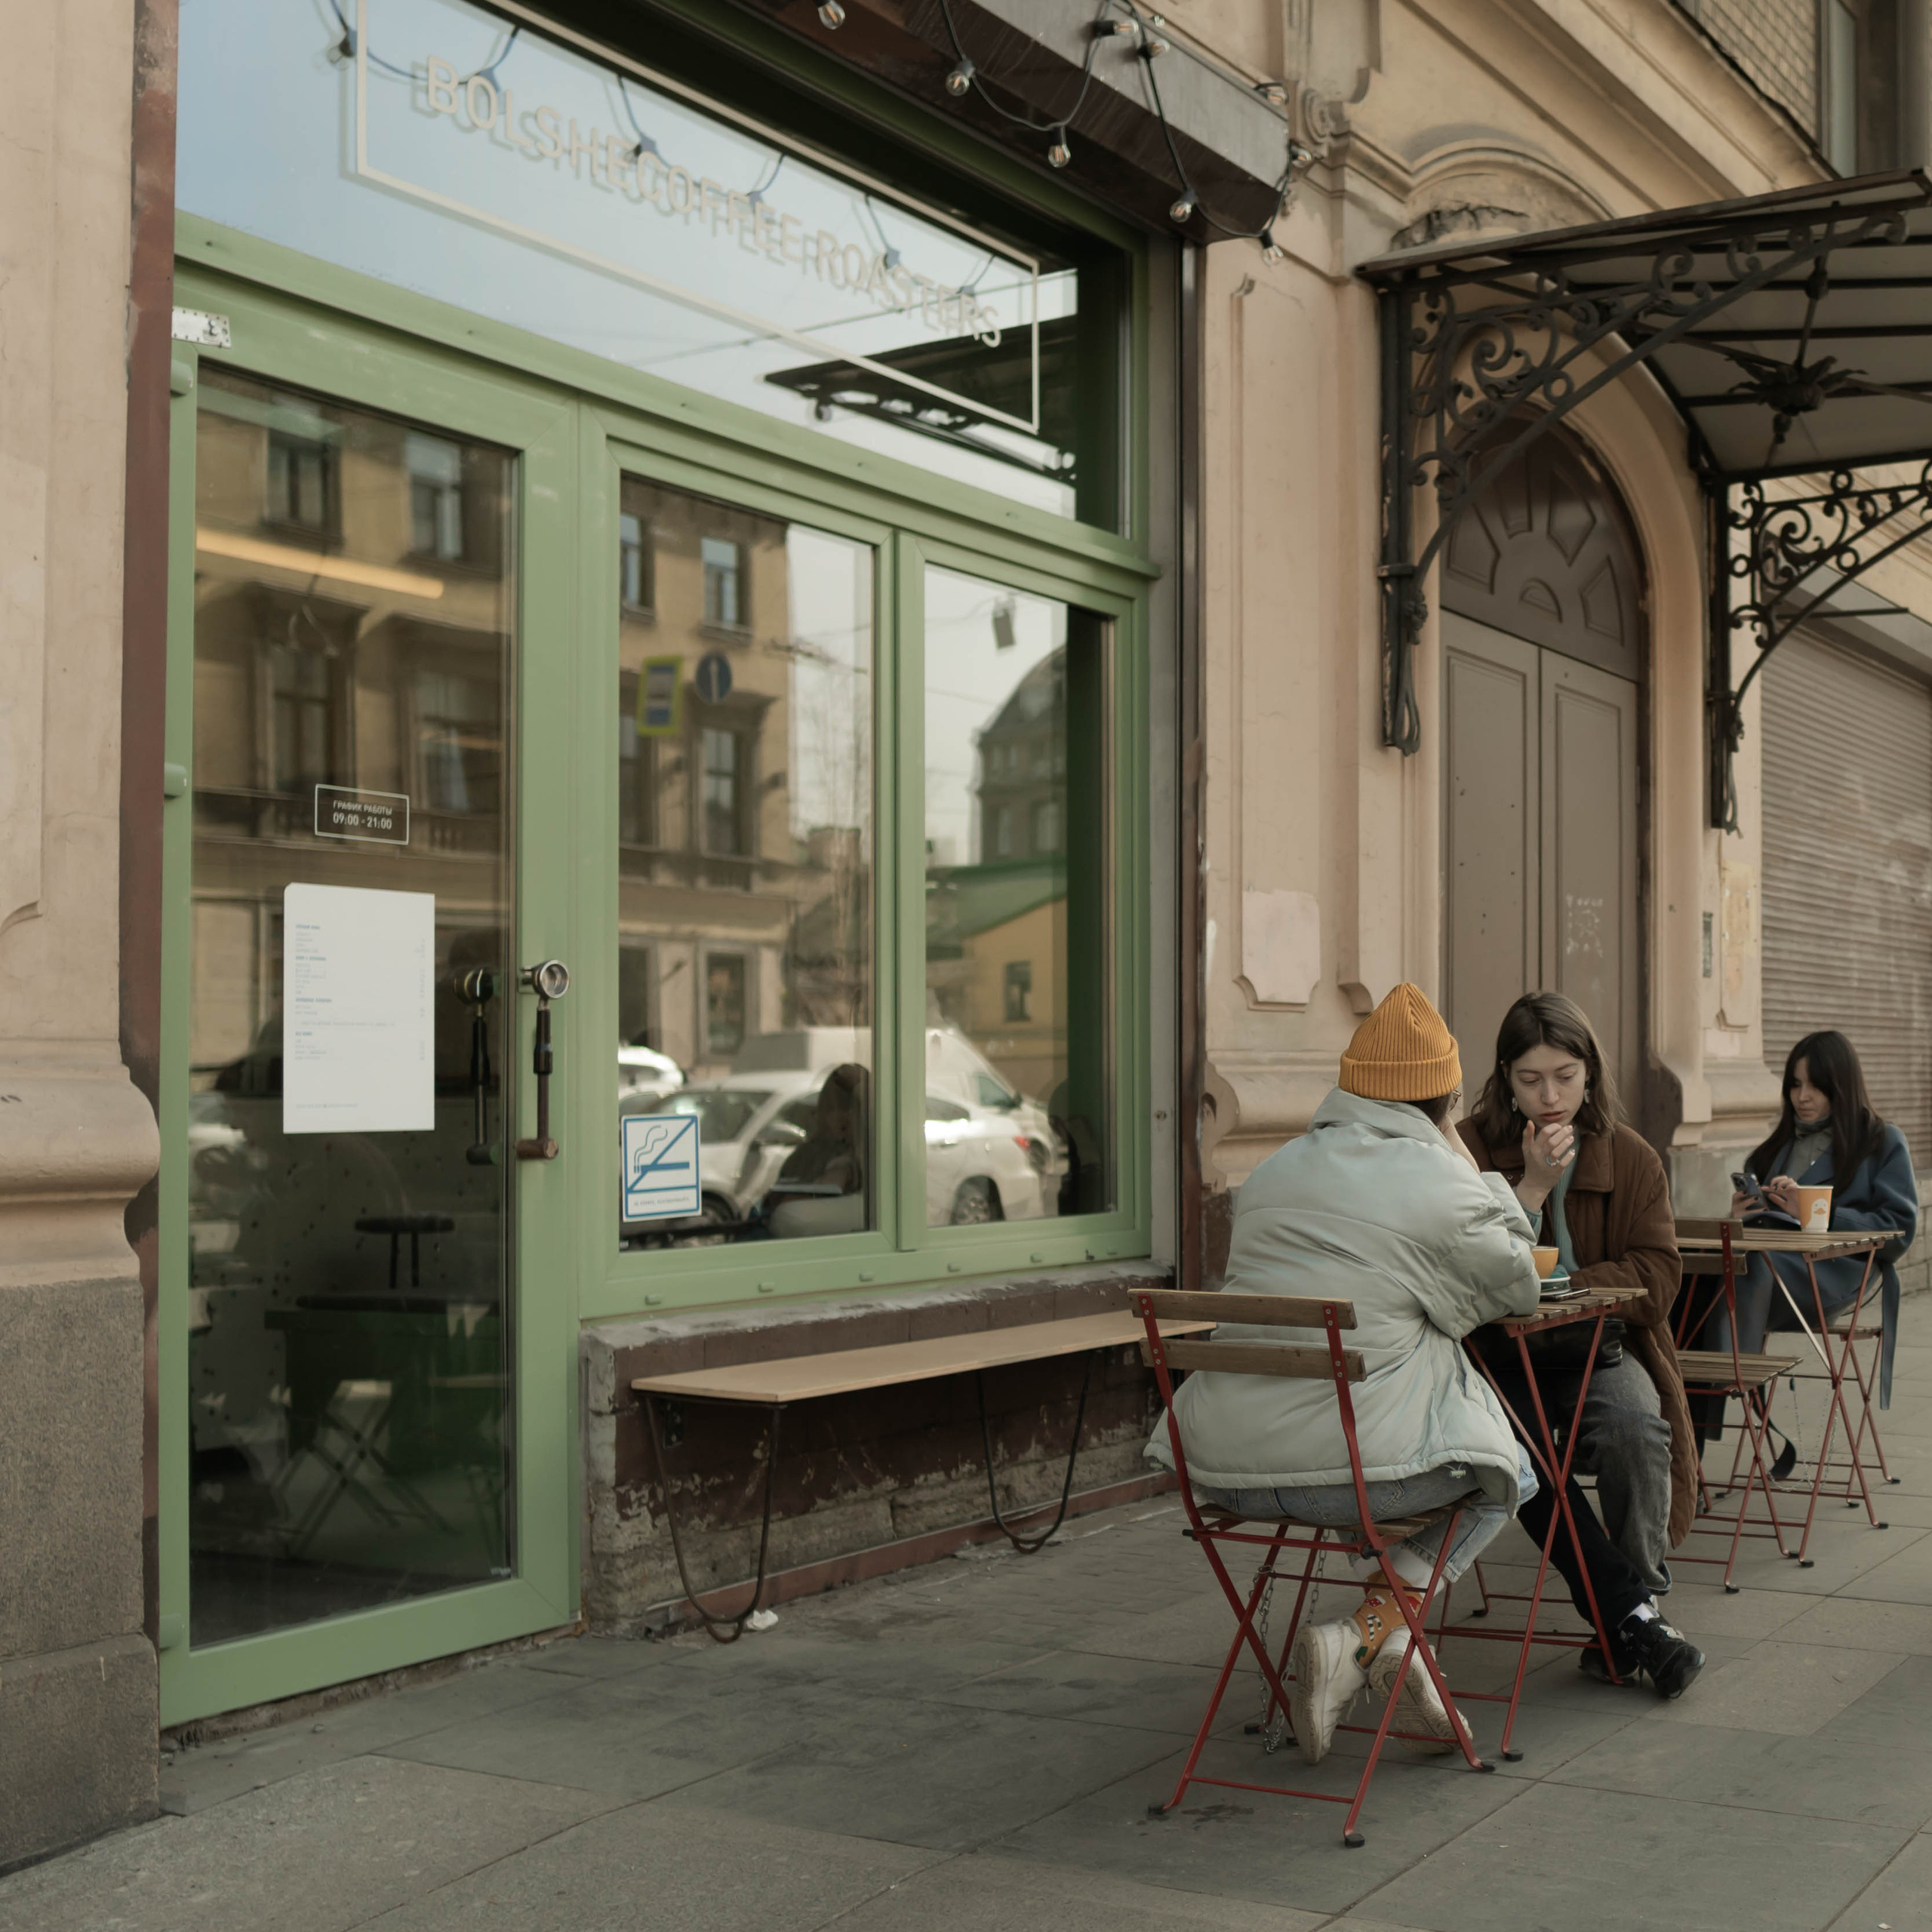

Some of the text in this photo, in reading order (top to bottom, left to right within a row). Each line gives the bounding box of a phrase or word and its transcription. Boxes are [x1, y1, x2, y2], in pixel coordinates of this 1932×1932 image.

[816, 229, 1001, 348] ROASTERS
[333, 799, 392, 816] ГРАФИК РАБОТЫ
[333, 811, 359, 826] 09:00
[367, 815, 392, 830] 21:00
